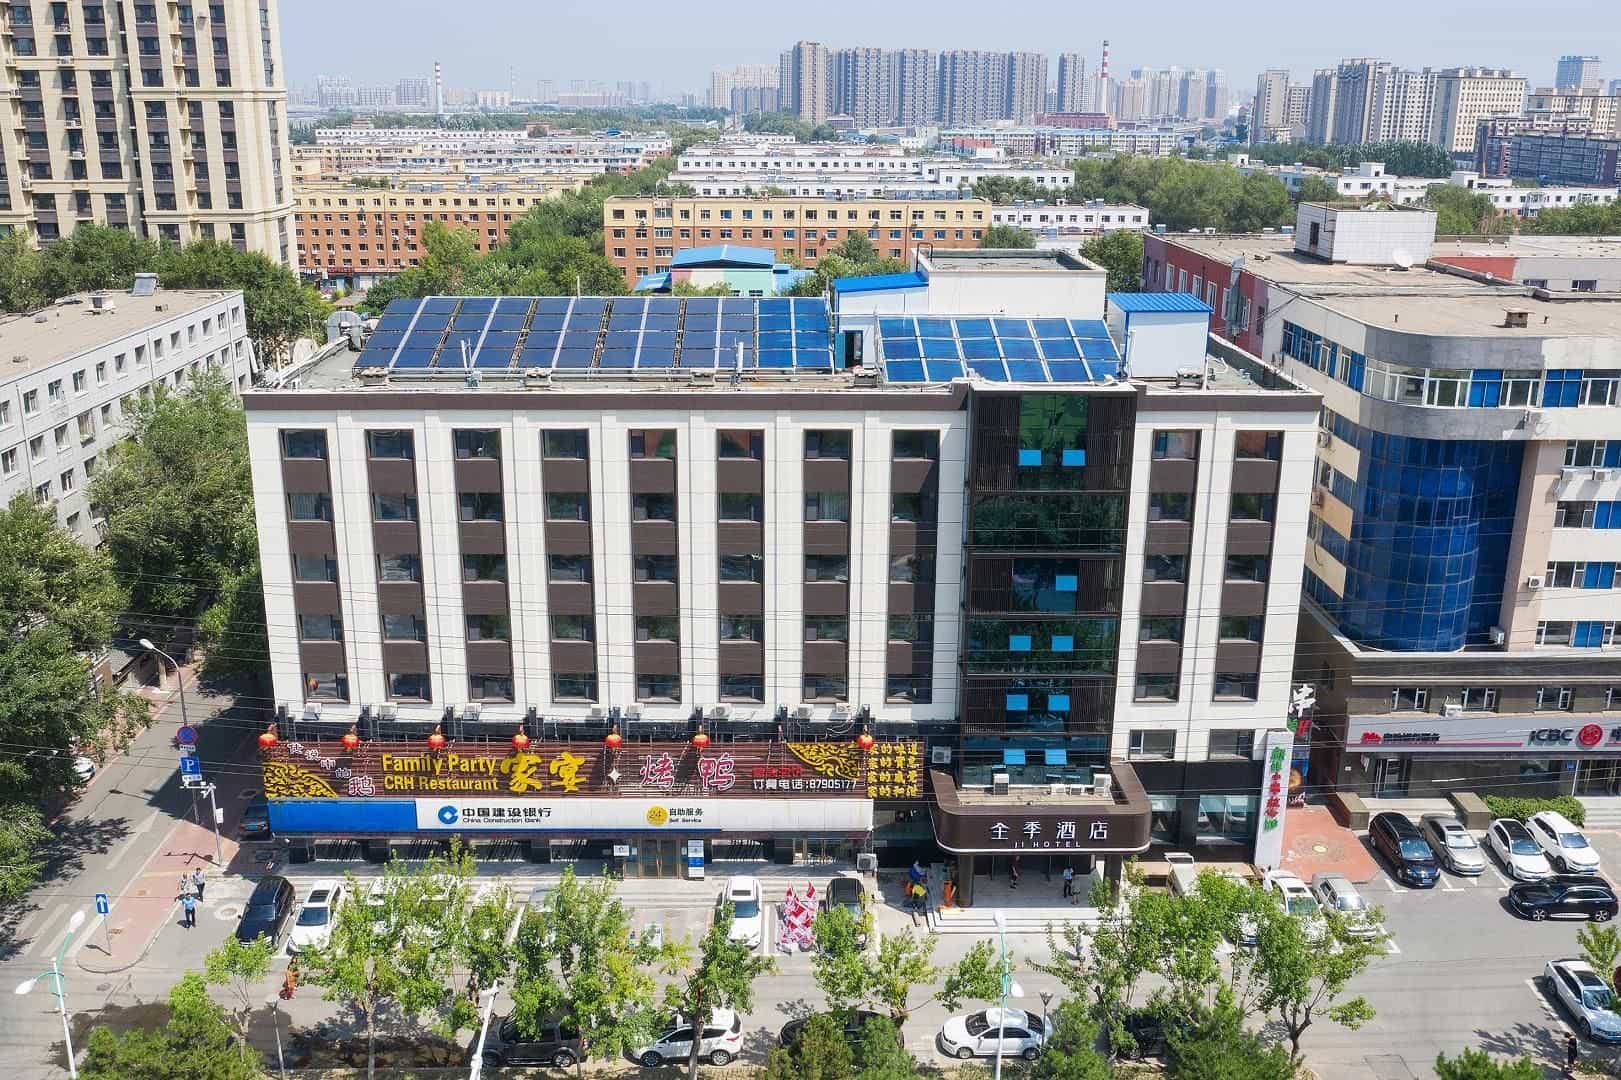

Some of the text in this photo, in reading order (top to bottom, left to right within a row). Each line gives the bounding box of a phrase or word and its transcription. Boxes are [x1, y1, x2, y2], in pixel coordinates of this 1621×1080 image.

[1529, 728, 1574, 744] ICBC
[382, 753, 496, 777] Family Party
[500, 752, 587, 793] 家宴
[639, 752, 737, 790] 烤鸭
[418, 776, 499, 792] Restaurant
[462, 807, 552, 818] 中国建设银行
[669, 807, 704, 816] 自助服务
[990, 821, 1109, 840] 全季酒店
